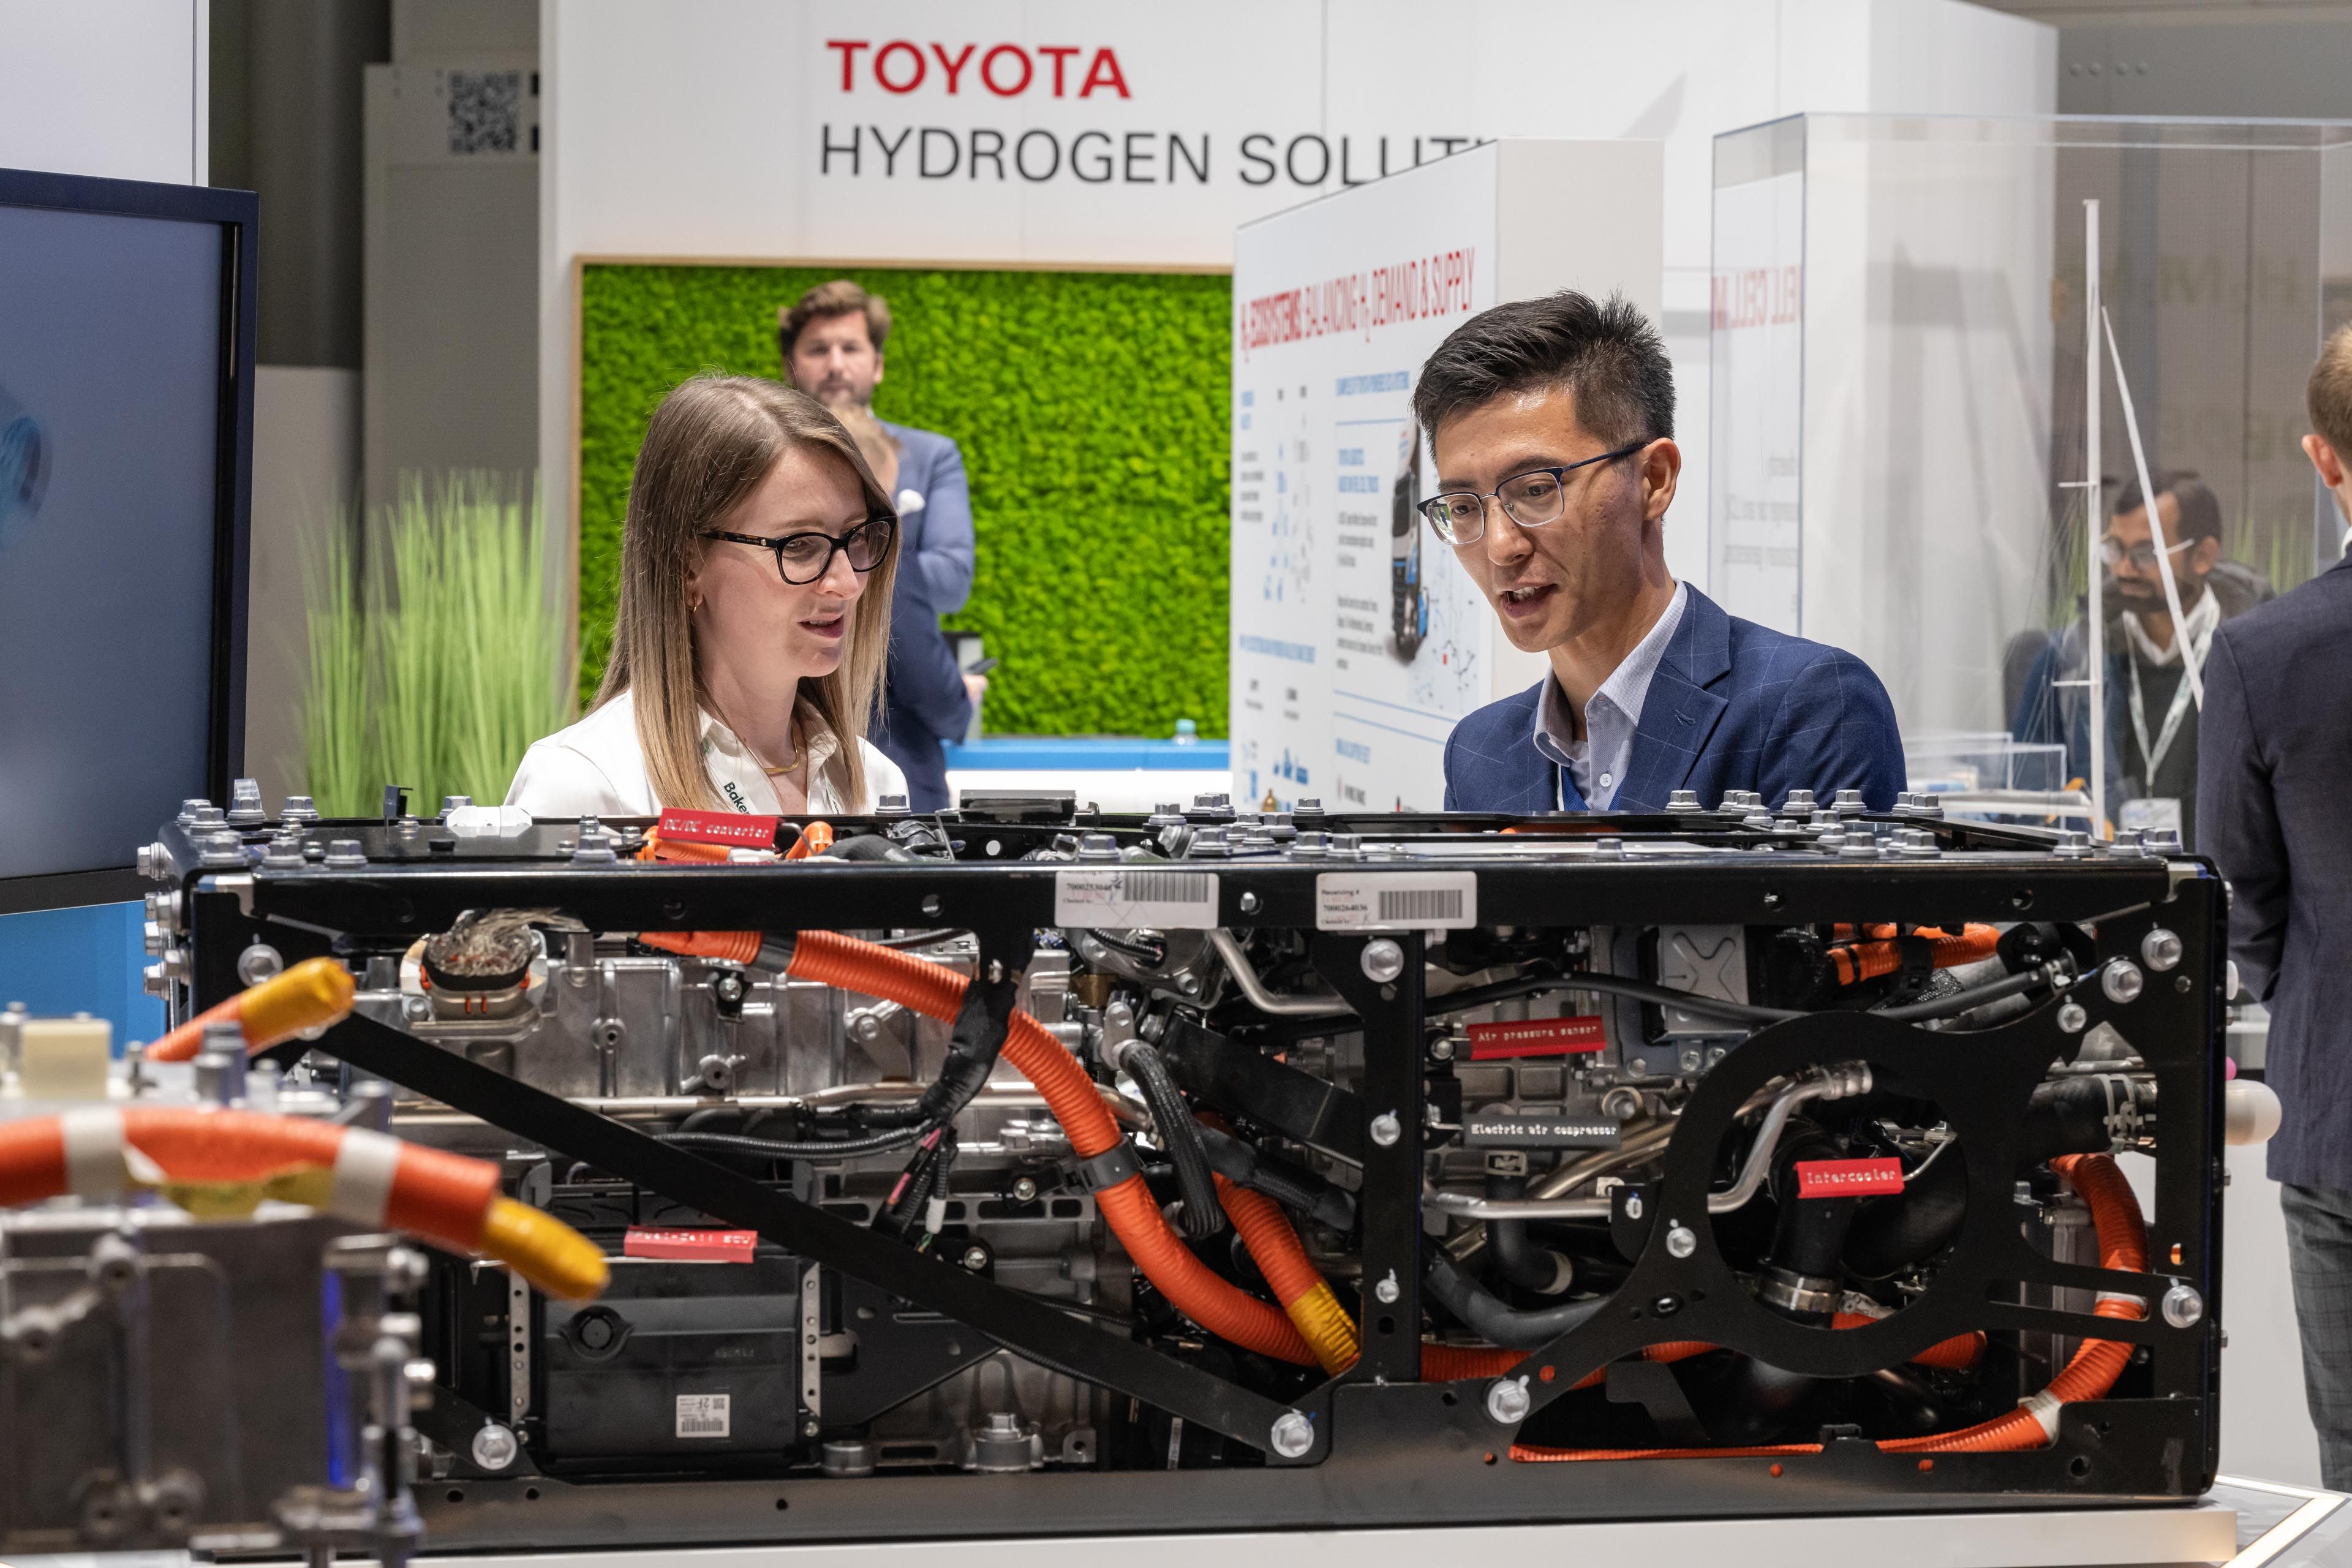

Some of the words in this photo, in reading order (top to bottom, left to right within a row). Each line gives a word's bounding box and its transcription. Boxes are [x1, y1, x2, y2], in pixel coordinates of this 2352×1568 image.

[826, 40, 1132, 99] TOYOTA
[821, 124, 1210, 184] HYDROGEN
[1240, 133, 1483, 186] SOLUT
[1305, 274, 1357, 337] BALANCING
[1373, 260, 1417, 326] DEMAND
[1420, 257, 1428, 319] &
[1431, 246, 1475, 316] SUPPLY
[663, 818, 701, 833] DC/DC
[706, 824, 769, 838] converter
[1477, 1032, 1498, 1041] Air
[1503, 1029, 1555, 1041] pressure
[1560, 1025, 1597, 1036] sensor
[1471, 1123, 1524, 1134] Electric
[1528, 1123, 1548, 1135] air
[1553, 1125, 1617, 1137] compressor
[1806, 1169, 1896, 1184] Intercooler
